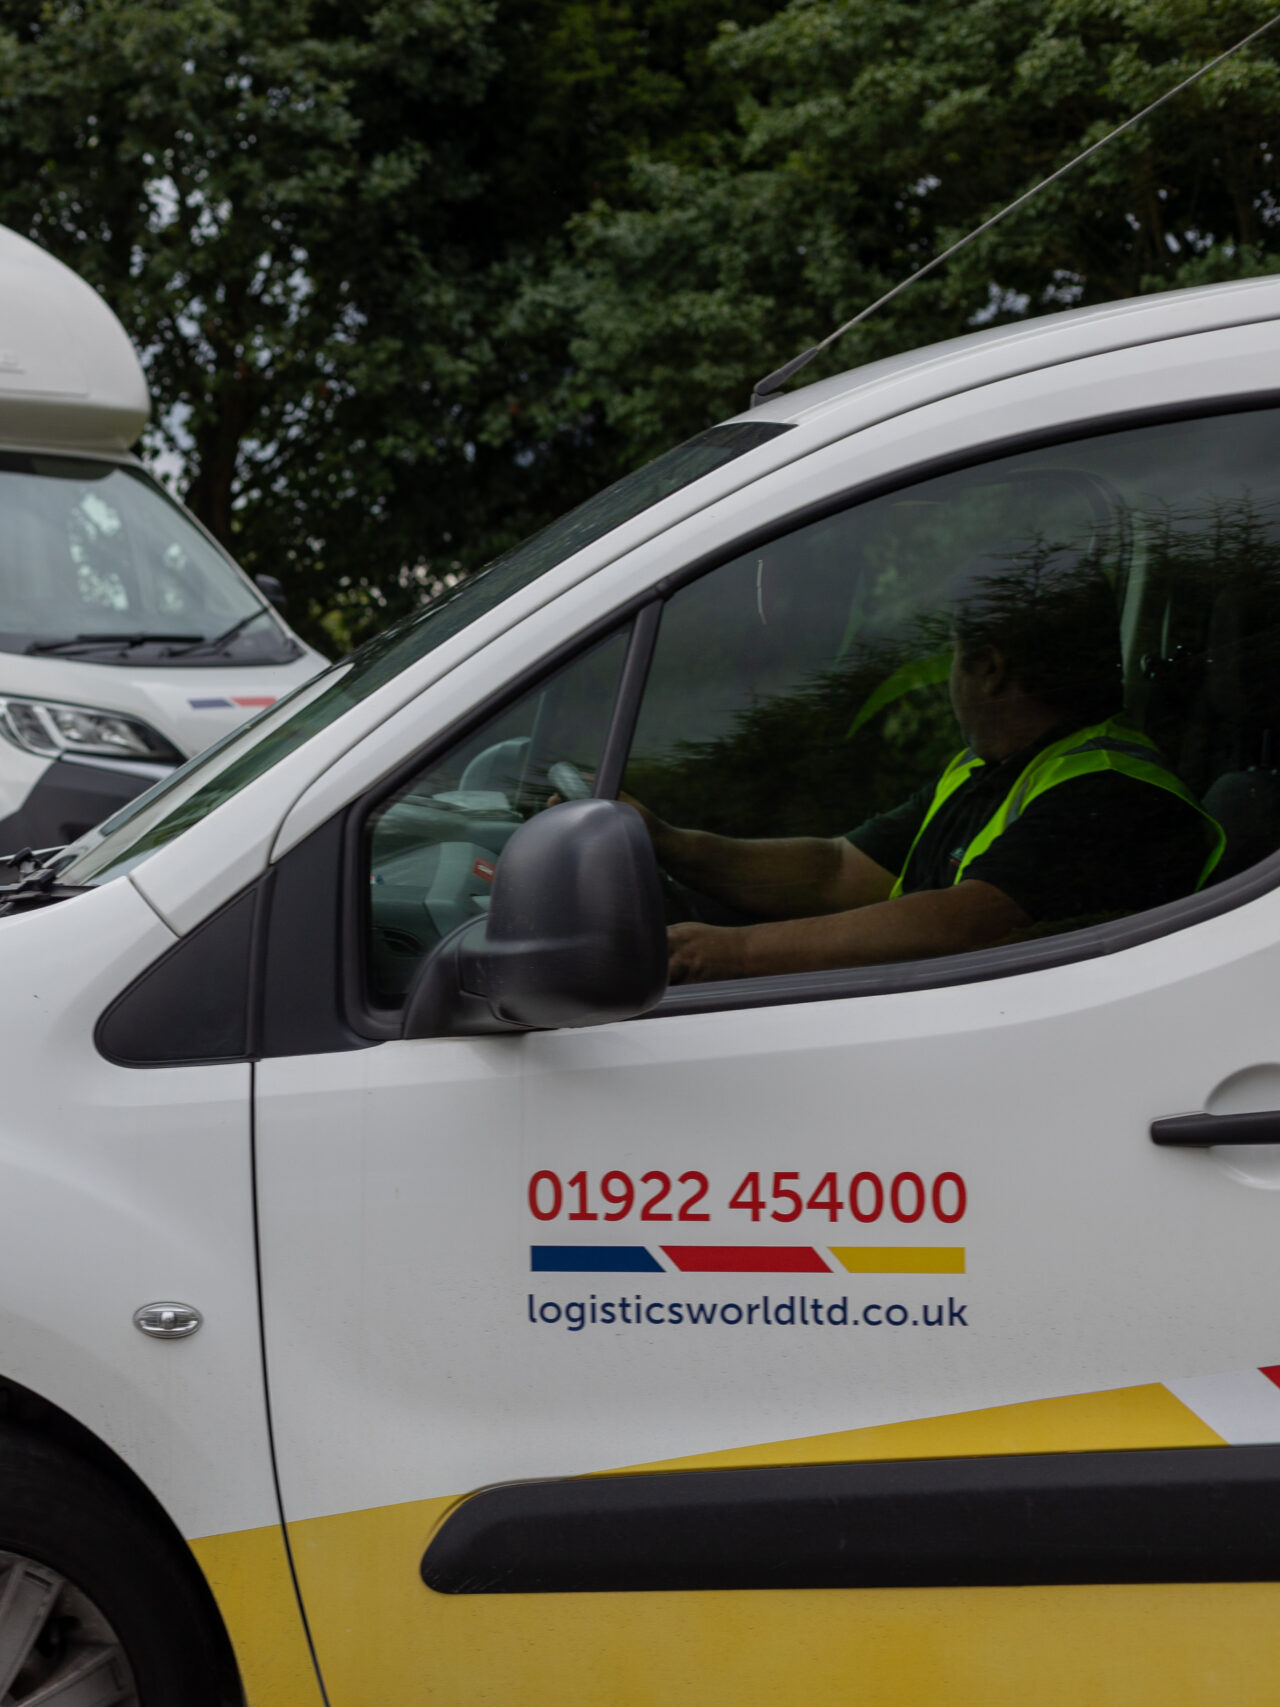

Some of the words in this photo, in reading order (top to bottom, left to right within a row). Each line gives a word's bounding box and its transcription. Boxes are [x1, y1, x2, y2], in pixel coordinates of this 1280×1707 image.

[527, 1169, 711, 1222] 01922
[728, 1170, 968, 1224] 454000
[526, 1294, 970, 1332] logisticsworldltd.co.uk
